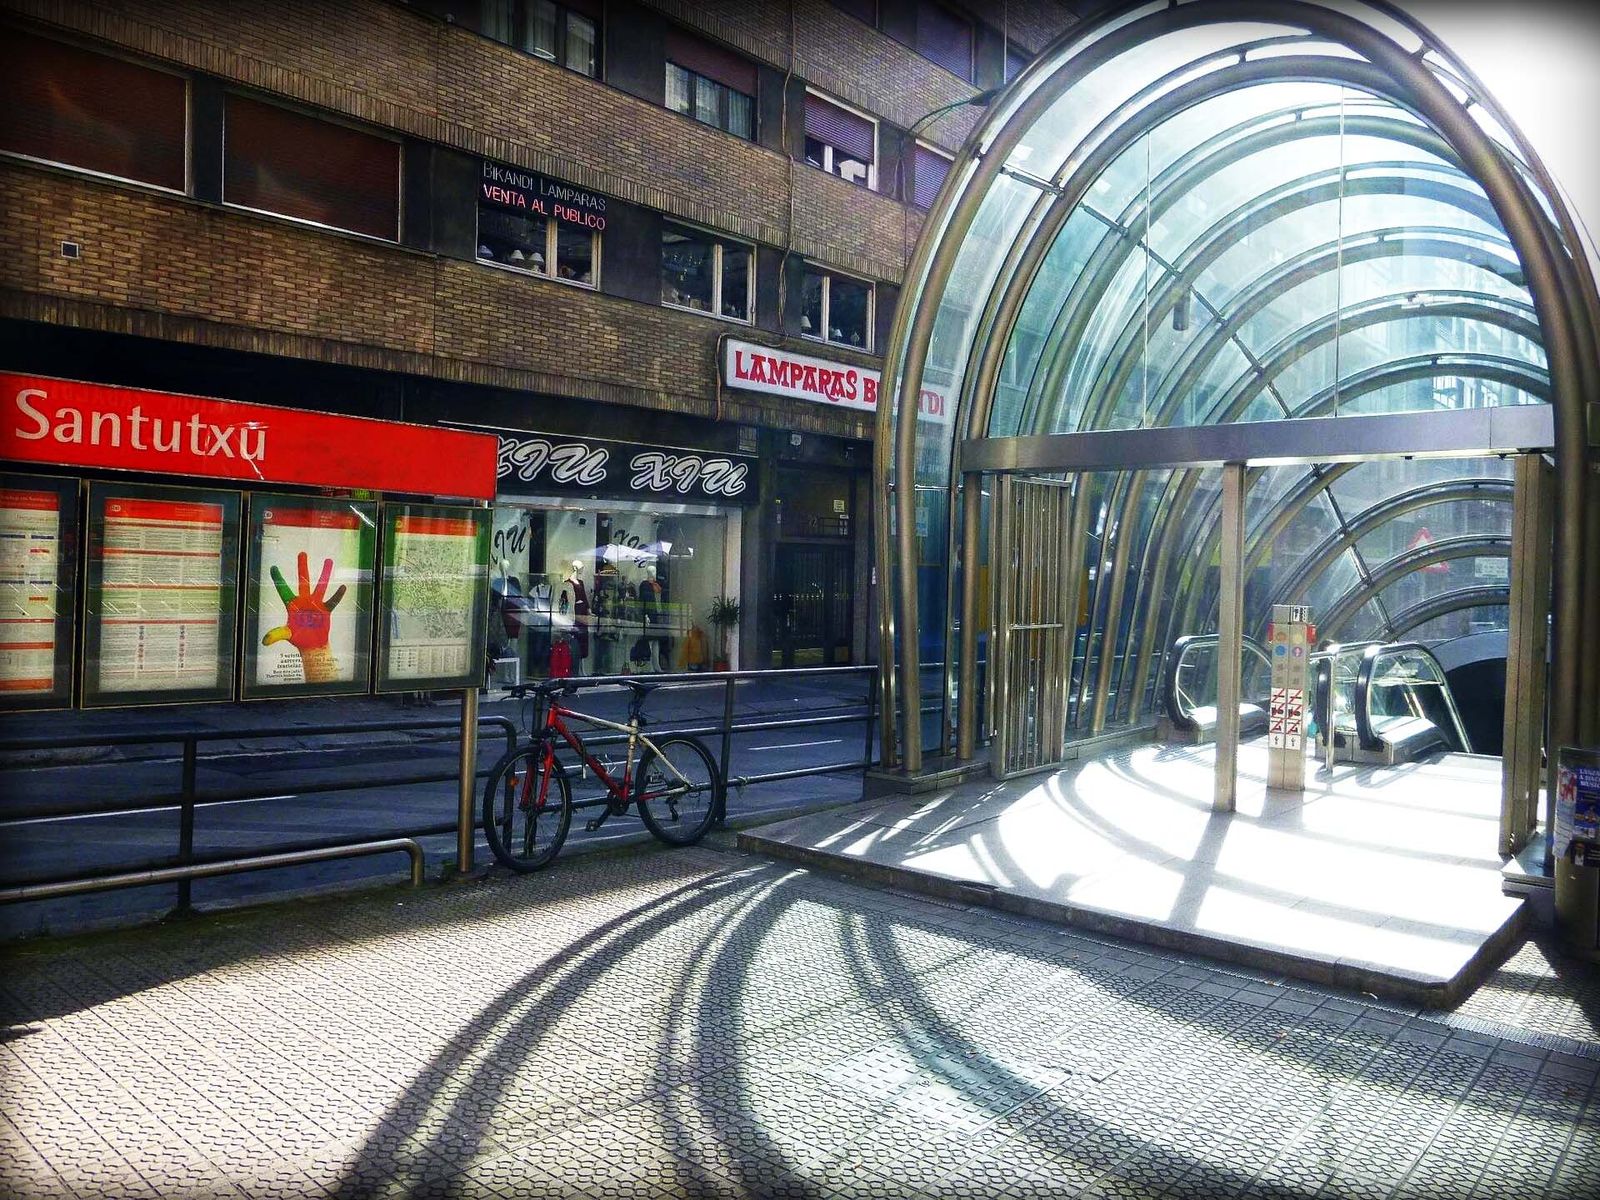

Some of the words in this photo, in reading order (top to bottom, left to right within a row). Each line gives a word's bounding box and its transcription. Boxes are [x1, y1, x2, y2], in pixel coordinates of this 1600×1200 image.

[483, 161, 533, 190] BIKANDI
[540, 178, 606, 211] LAMPARAS
[483, 183, 526, 208] VENTA
[531, 199, 548, 215] AL
[554, 204, 606, 230] PUBLICO
[735, 350, 857, 402] LAMPARAS
[15, 388, 266, 461] Santutxu
[630, 452, 748, 497] XIU
